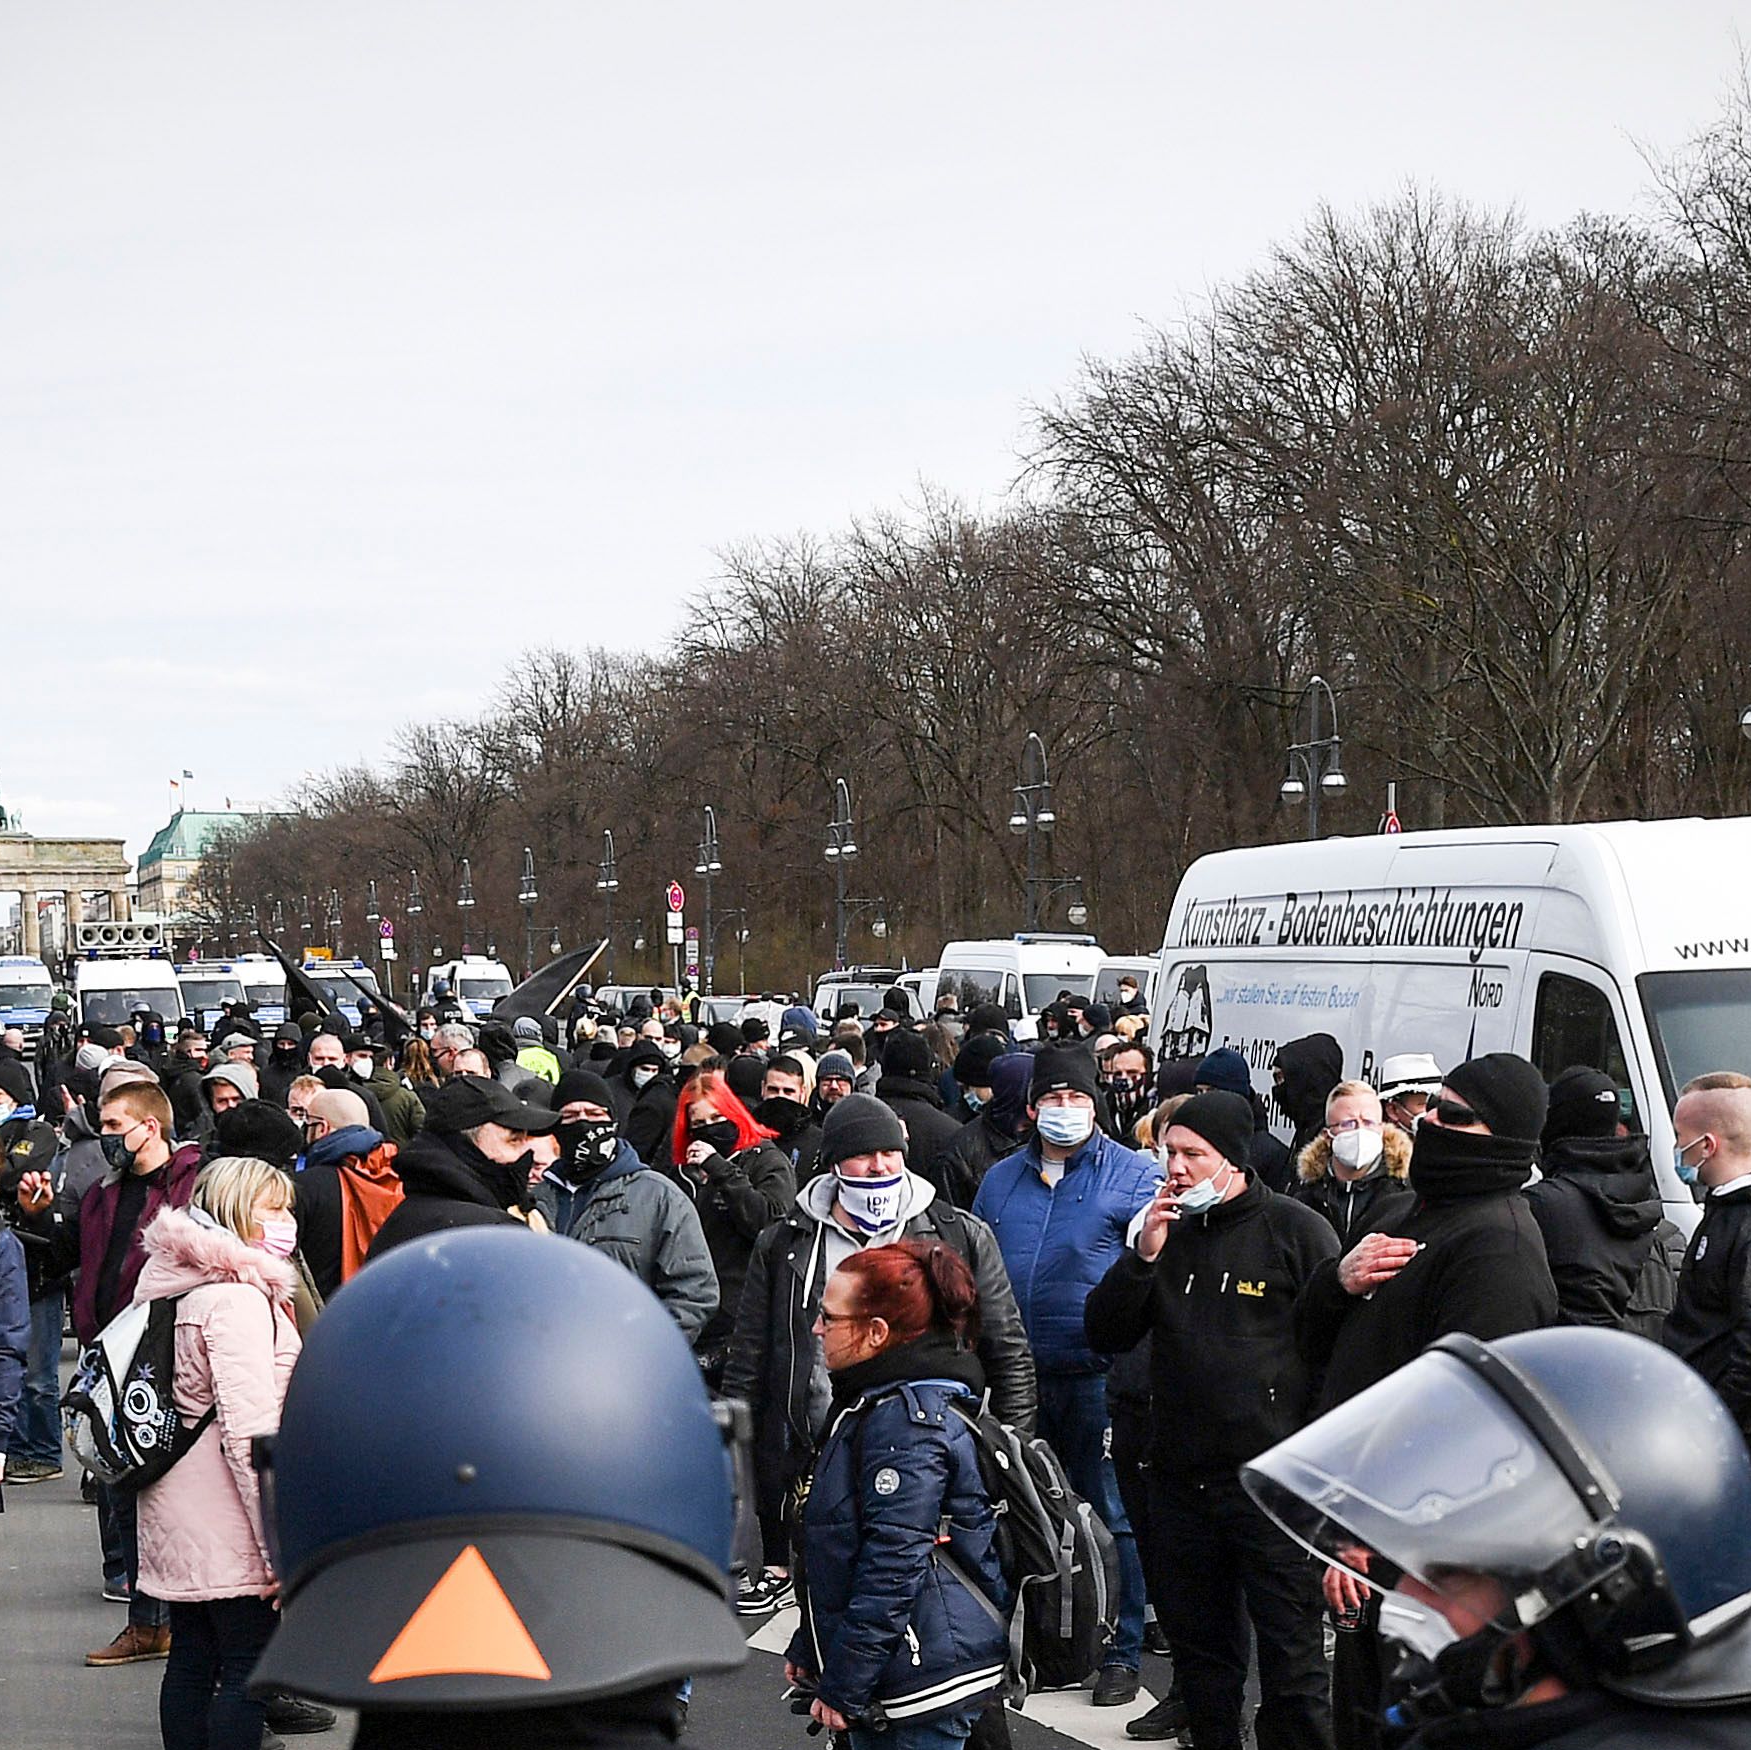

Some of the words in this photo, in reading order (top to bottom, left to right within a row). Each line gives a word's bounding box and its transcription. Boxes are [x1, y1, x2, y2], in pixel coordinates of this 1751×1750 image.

[1178, 894, 1266, 947] Kunstharz
[1277, 887, 1524, 963] Bodenbeschichtungen
[1328, 985, 1360, 1009] Boden
